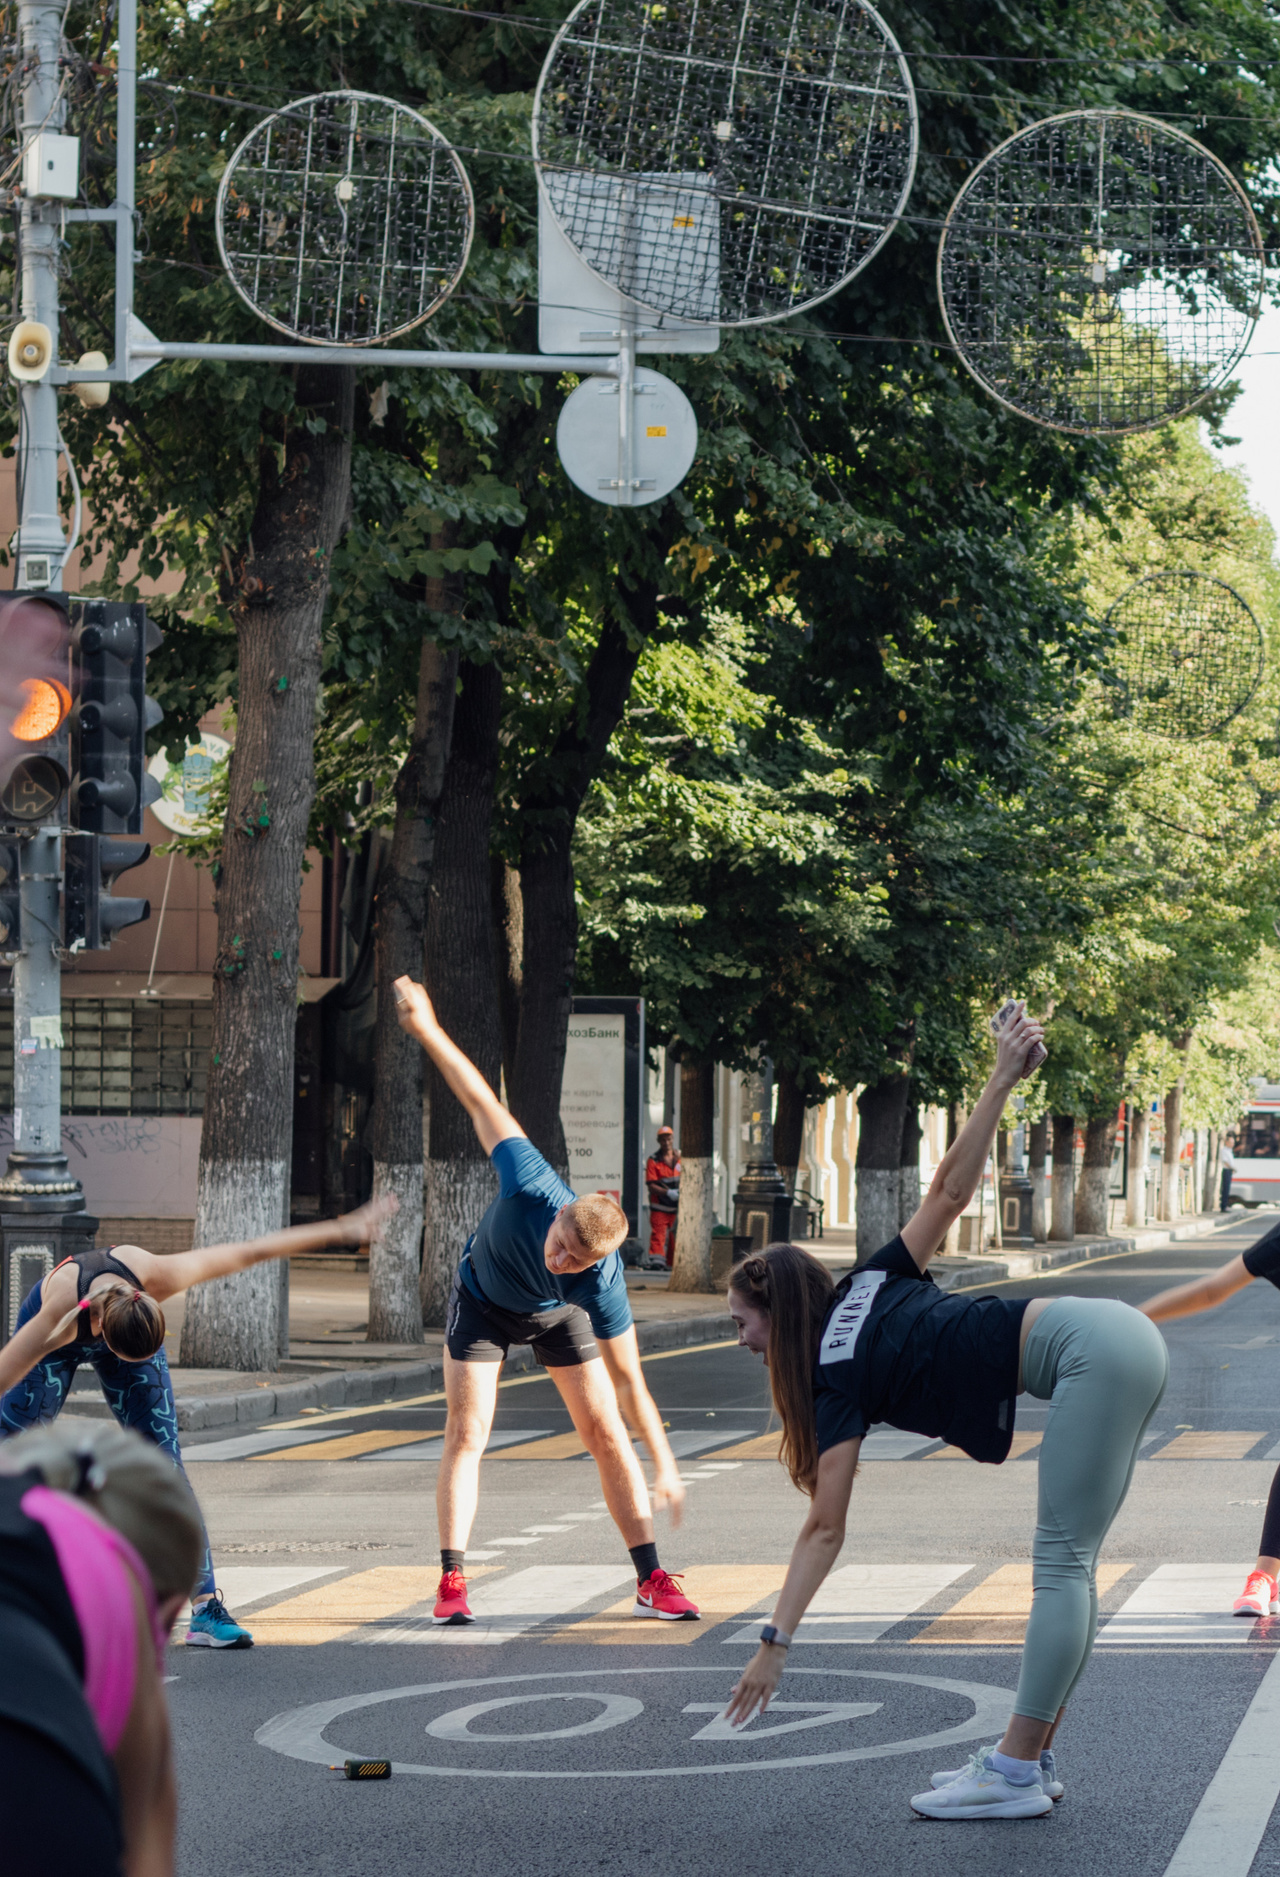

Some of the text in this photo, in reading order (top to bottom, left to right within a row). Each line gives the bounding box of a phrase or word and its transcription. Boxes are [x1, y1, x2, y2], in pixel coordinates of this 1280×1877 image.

[568, 1027, 620, 1038] хозБанк
[573, 1089, 604, 1098] карты
[567, 1120, 620, 1128] переводы
[575, 1147, 593, 1157] 100
